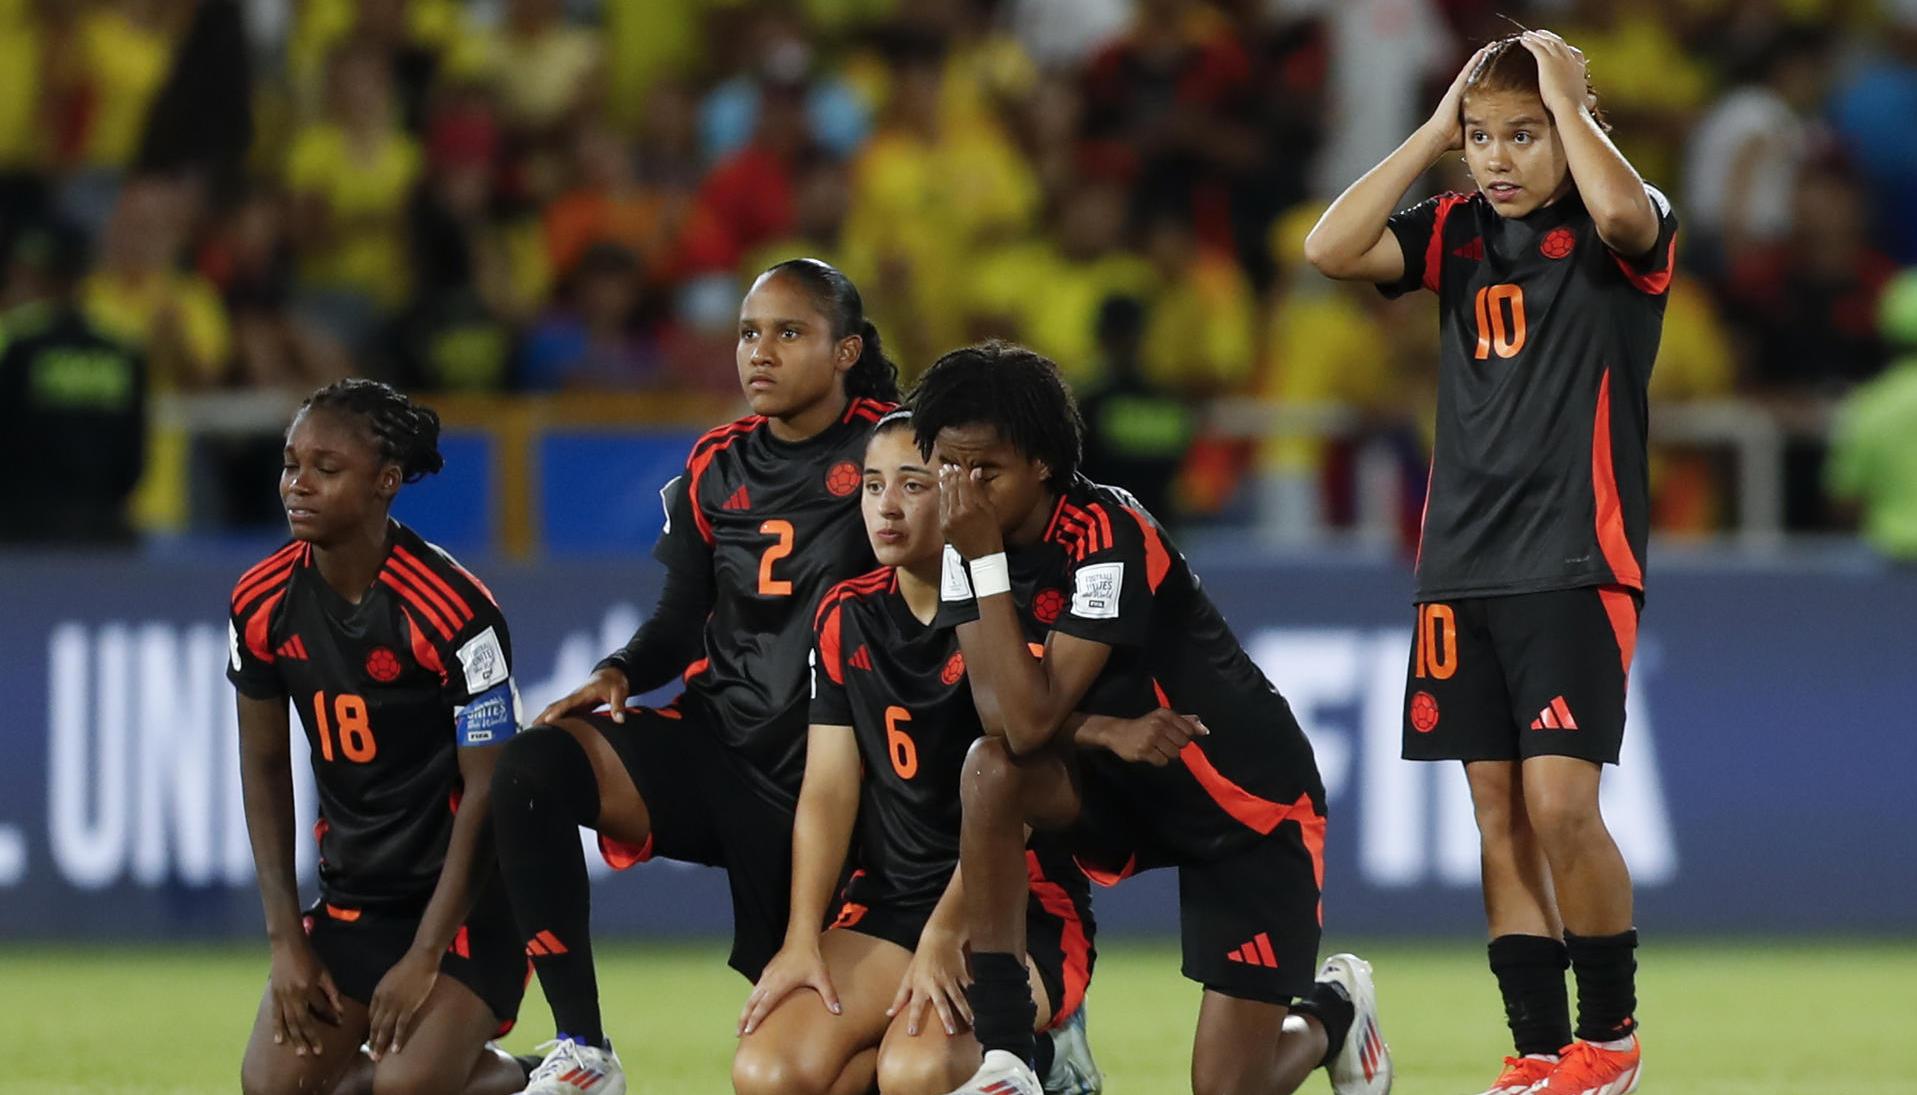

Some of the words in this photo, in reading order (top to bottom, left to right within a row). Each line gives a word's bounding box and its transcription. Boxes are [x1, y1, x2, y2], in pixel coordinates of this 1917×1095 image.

[1474, 283, 1527, 360] 10
[758, 519, 795, 596] 2
[1416, 602, 1458, 680] 10
[313, 690, 377, 763] 18
[884, 705, 918, 780] 6
[1247, 626, 1680, 890] FIA
